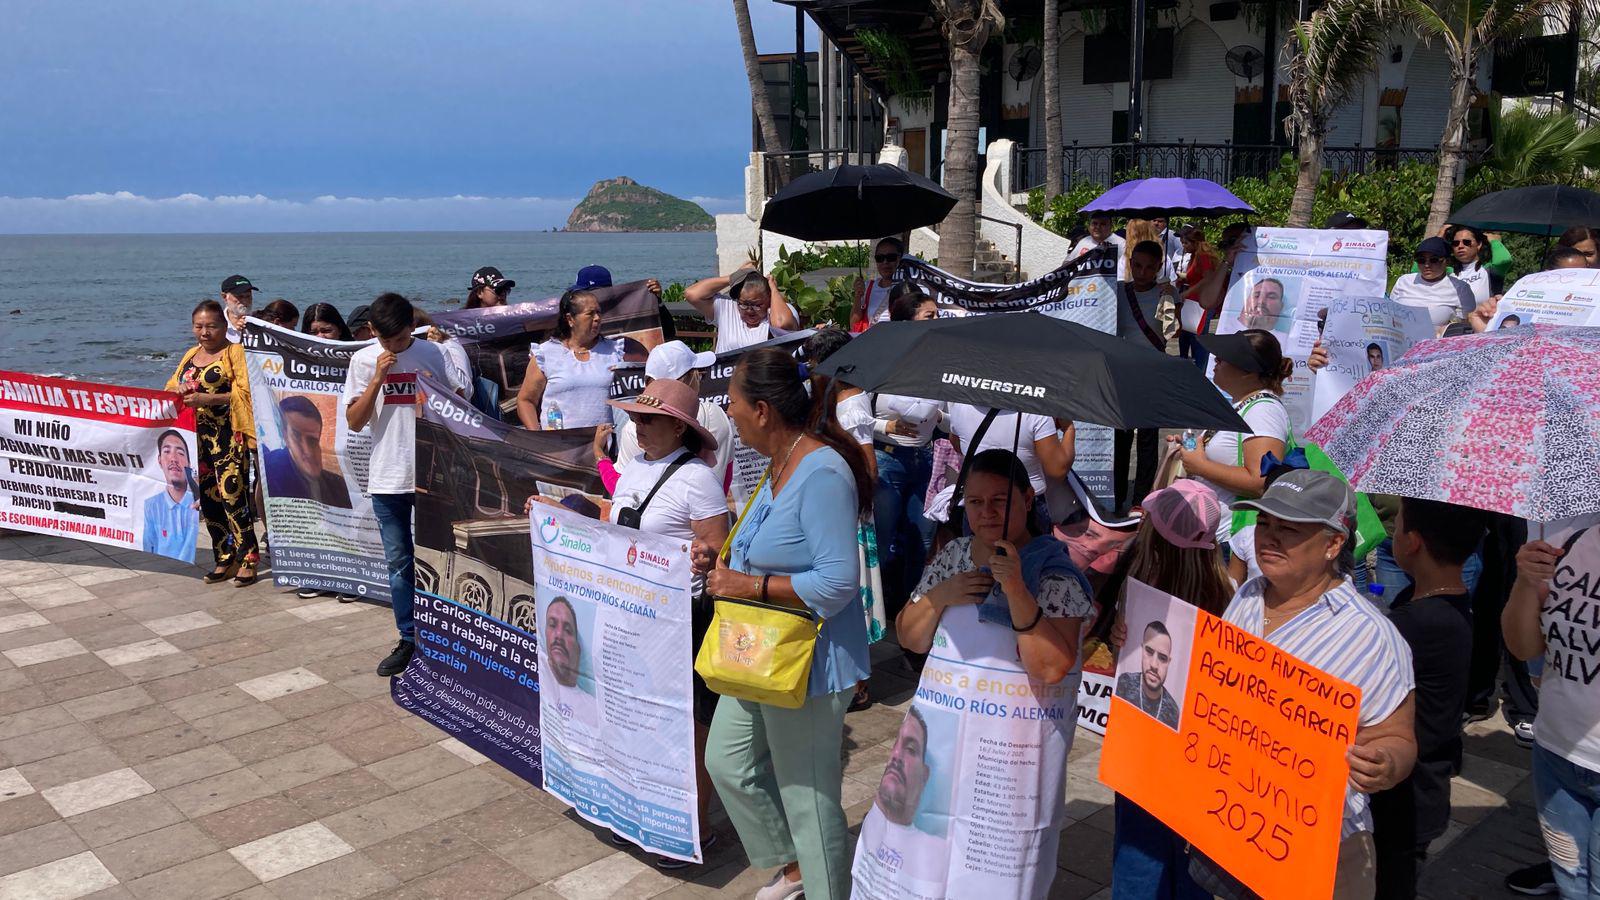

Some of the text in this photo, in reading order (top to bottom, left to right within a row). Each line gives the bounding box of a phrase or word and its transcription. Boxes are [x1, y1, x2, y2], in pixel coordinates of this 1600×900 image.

[1272, 268, 1307, 277] ANTONIO
[937, 291, 954, 305] lo
[1086, 283, 1097, 293] a
[290, 359, 307, 374] lo
[289, 379, 330, 392] CARLOS
[383, 382, 416, 396] evi
[941, 372, 1046, 398] UNIVERSTAR
[67, 389, 93, 412] TE
[94, 391, 178, 420] ESPERAN
[14, 418, 71, 441] MI NIÑO
[0, 436, 144, 468] AGUANTO MAS SIN TI
[9, 458, 98, 485] PERDONAME.
[0, 479, 128, 508] DEBIMOS REGRESAR A ESTE
[11, 495, 52, 511] RANCHO
[0, 511, 135, 544] S ESCUINAPA SINALOA MALDITO
[274, 549, 285, 557] Si
[289, 550, 316, 559] tienes
[560, 534, 591, 554] Sinaloa
[361, 568, 370, 576] Tu
[640, 551, 670, 568] SINALOA
[322, 579, 335, 587] 327
[607, 577, 657, 601] encontrar
[661, 595, 668, 605] a
[433, 599, 472, 624] Carlos
[548, 575, 657, 620] LUIS ANTONIO RÍOS ALEMÁN
[413, 610, 539, 674] udir a trabajar a la ca
[1547, 621, 1600, 656] ALV
[420, 629, 541, 692] caso de mujeres des
[1200, 615, 1356, 710] MARCO ANTONIO
[1548, 650, 1600, 686] ALV
[958, 675, 970, 690] a
[440, 674, 453, 687] del
[452, 678, 477, 701] joven
[476, 696, 497, 713] pide
[497, 707, 526, 729] ayuda
[916, 686, 1065, 721] ANTONIO RÍOS ALEMÁN
[1200, 651, 1350, 745] AGUIRRE GARCIA
[435, 688, 486, 723] desapareció
[485, 718, 513, 739] desde
[1193, 692, 1316, 779] DESAPARECIO
[1184, 732, 1199, 763] 8
[1207, 744, 1232, 776] DE
[1207, 788, 1293, 862] 2025
